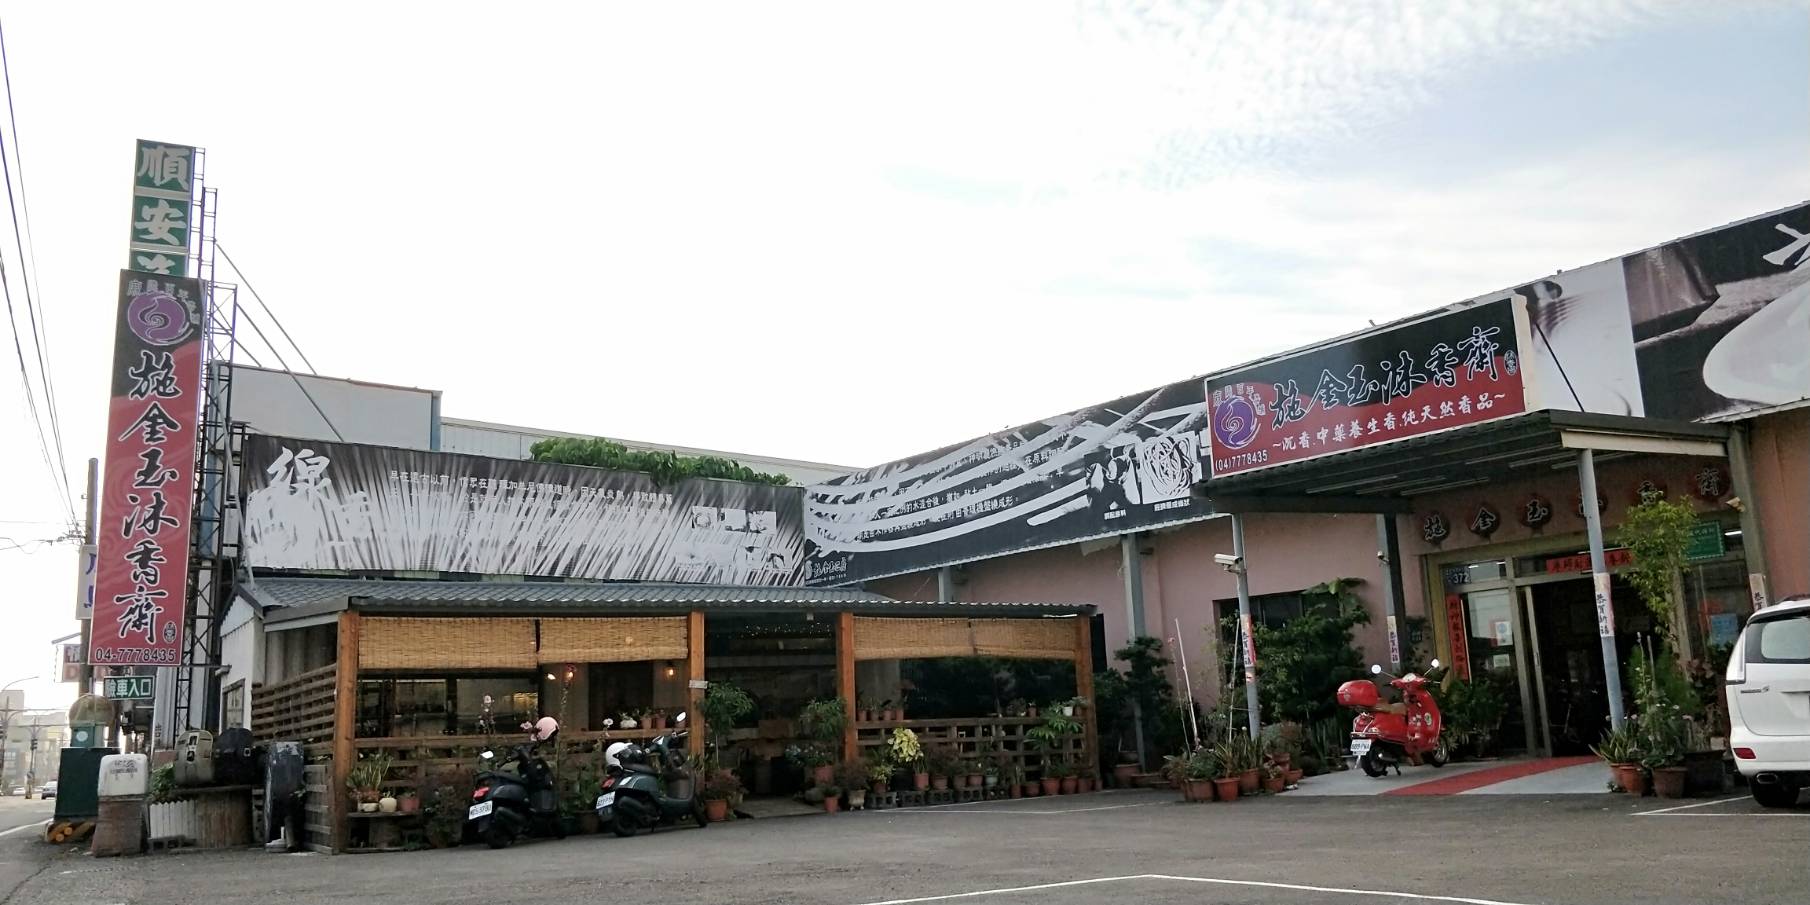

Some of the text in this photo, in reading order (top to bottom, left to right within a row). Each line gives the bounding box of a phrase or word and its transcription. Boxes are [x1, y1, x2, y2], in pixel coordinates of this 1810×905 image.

[135, 145, 190, 276] 順安
[1215, 449, 1268, 471] (04)7778435
[1453, 572, 1469, 584] 372
[95, 649, 176, 662] 04-7778435
